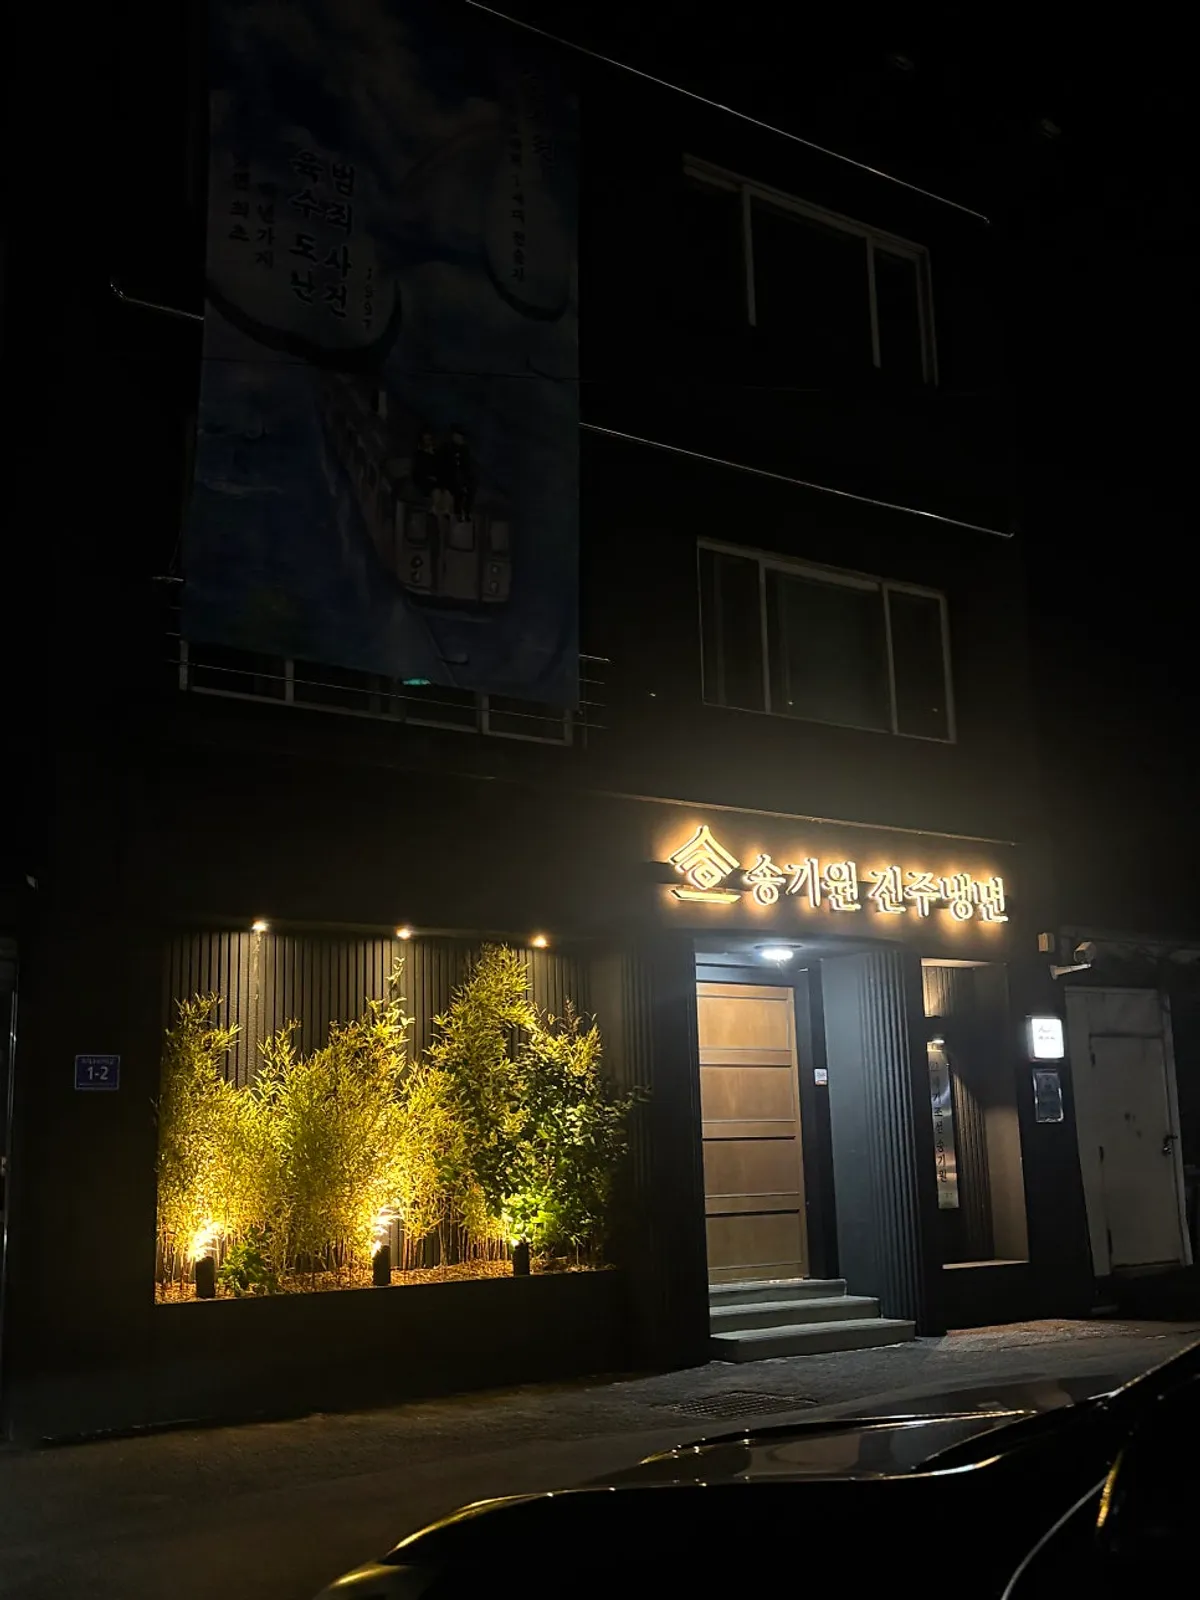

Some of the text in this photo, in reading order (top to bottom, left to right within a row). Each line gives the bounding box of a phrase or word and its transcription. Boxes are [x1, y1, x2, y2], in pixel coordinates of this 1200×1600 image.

[743, 853, 1010, 924] 송기원 진주냉면
[87, 1065, 109, 1080] 1-2
